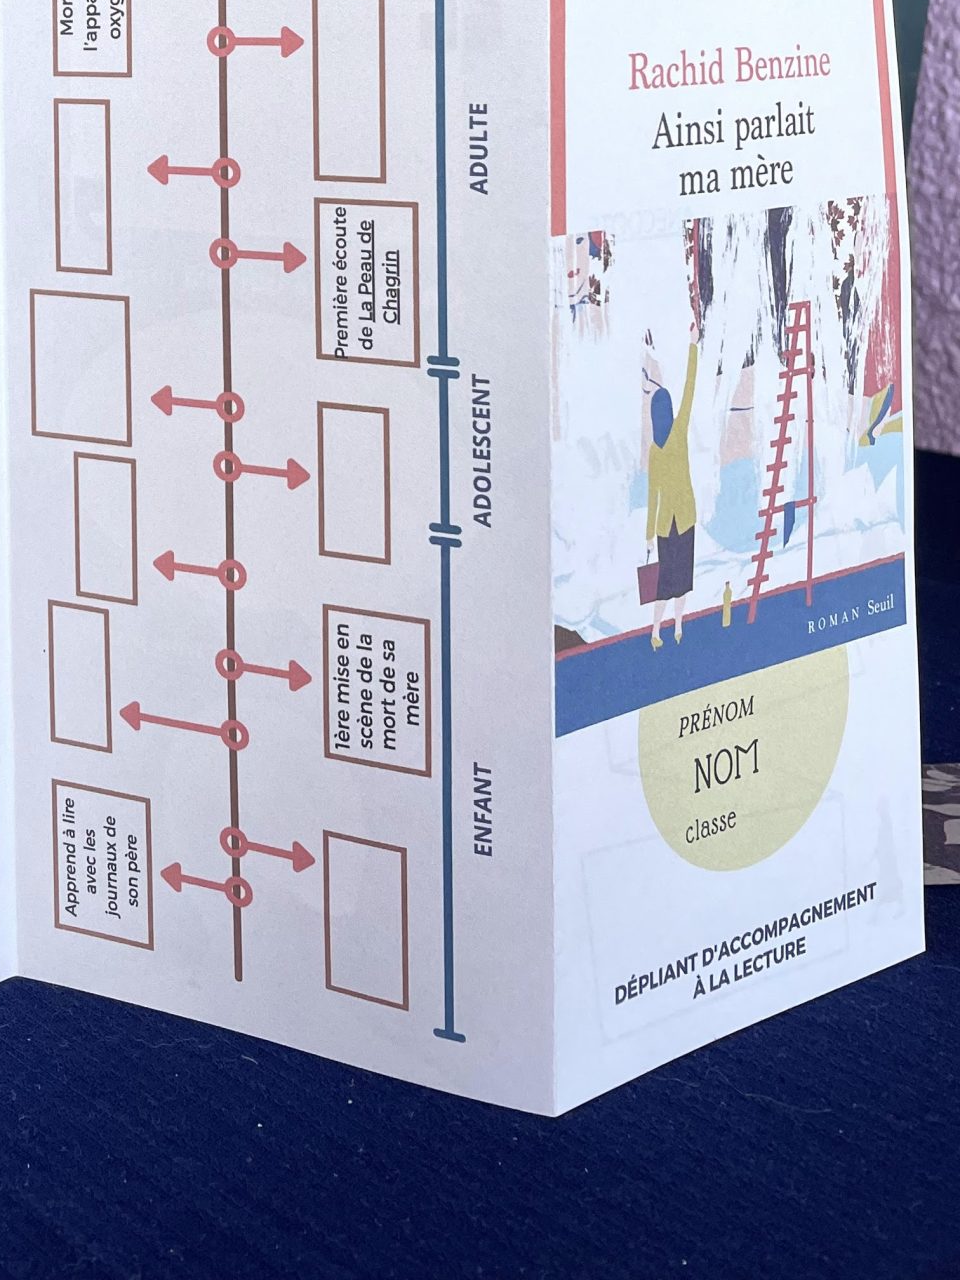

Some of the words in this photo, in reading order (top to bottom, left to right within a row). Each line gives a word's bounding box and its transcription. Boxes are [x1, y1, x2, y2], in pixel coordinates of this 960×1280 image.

[628, 47, 725, 91] Rachid
[734, 44, 831, 83] Benzine
[651, 108, 725, 150] Ainsi
[735, 100, 816, 151] parlait
[469, 103, 489, 196] ADULTE
[679, 168, 721, 197] ma
[730, 153, 793, 190] mère
[332, 206, 347, 271] écoute
[357, 220, 374, 244] de
[357, 248, 375, 295] Peau
[382, 250, 401, 325] Chagrin
[331, 275, 349, 360] Première
[358, 300, 376, 323] La
[357, 326, 373, 350] de
[472, 373, 492, 528] ADOLESCENT
[807, 606, 860, 634] ROMAN
[867, 593, 895, 616] Seuil
[337, 623, 350, 649] en
[356, 633, 372, 651] la
[383, 639, 395, 662] sa
[333, 655, 350, 704] mise
[356, 657, 372, 683] de
[379, 666, 395, 693] de
[356, 688, 373, 749] scène
[402, 671, 419, 726] mère
[678, 695, 755, 739] PRÉNOM
[334, 709, 350, 749] 1ère
[381, 698, 396, 750] mort
[694, 738, 759, 794] NOM
[62, 797, 75, 824] lire
[103, 815, 116, 838] de
[473, 762, 493, 857] ENFANT
[685, 809, 738, 844] classe
[63, 828, 75, 839] à
[83, 829, 96, 852] les
[124, 834, 141, 873] père
[63, 841, 80, 917] Apprend
[85, 856, 97, 895] avec
[105, 841, 121, 919] journaux
[127, 877, 139, 908] son
[614, 952, 698, 1006] DÉPLIANT
[701, 882, 878, 967] D'ACCOMPAGNEMENT
[692, 973, 706, 1000] À
[709, 970, 731, 994] LA
[733, 936, 808, 985] LECTURE
